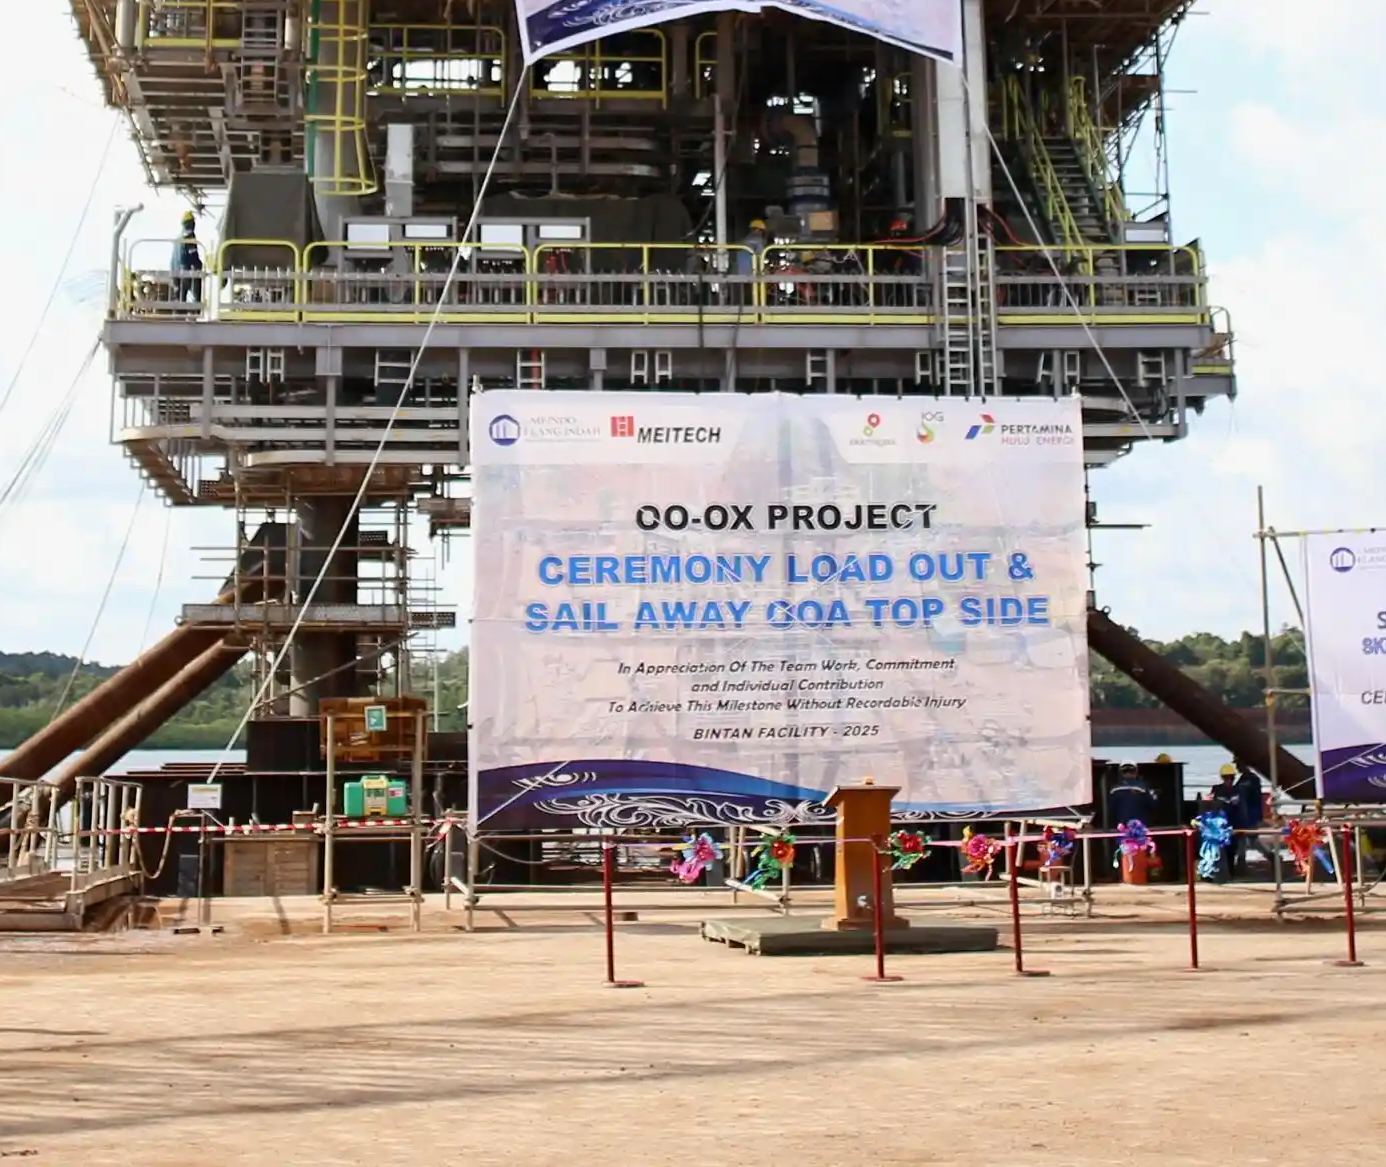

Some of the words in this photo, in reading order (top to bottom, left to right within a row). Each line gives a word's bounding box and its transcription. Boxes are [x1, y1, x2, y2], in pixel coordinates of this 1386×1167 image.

[637, 427, 721, 443] MEITECH
[1001, 424, 1073, 435] PERTAMINA
[768, 504, 937, 530] PROJECT
[538, 554, 772, 585] CEREMONY
[787, 552, 895, 584] LOAD
[908, 551, 993, 581] OUT
[1007, 551, 1035, 581] &
[524, 601, 620, 632] SAIL
[634, 600, 752, 631] AWAY
[865, 597, 945, 628] TOP
[960, 596, 1050, 627] SIDE
[618, 662, 631, 674] In
[635, 661, 725, 676] Appreciation
[728, 661, 746, 673] Of
[750, 660, 775, 673] The
[780, 660, 817, 672] Team
[821, 659, 861, 672] Work,
[865, 658, 956, 671] Commitment
[691, 680, 719, 693] and
[722, 680, 795, 692] Individual
[798, 679, 884, 691] Contribution
[608, 701, 624, 713] To
[628, 701, 682, 713] Achieve
[686, 700, 712, 712] This
[716, 699, 782, 712] Milestone
[787, 697, 843, 710] Without
[846, 696, 922, 709] Recordable
[925, 695, 967, 710] Injury
[693, 727, 754, 740] BINTAN
[758, 726, 830, 739] FACILITY
[843, 725, 880, 737] 2025
